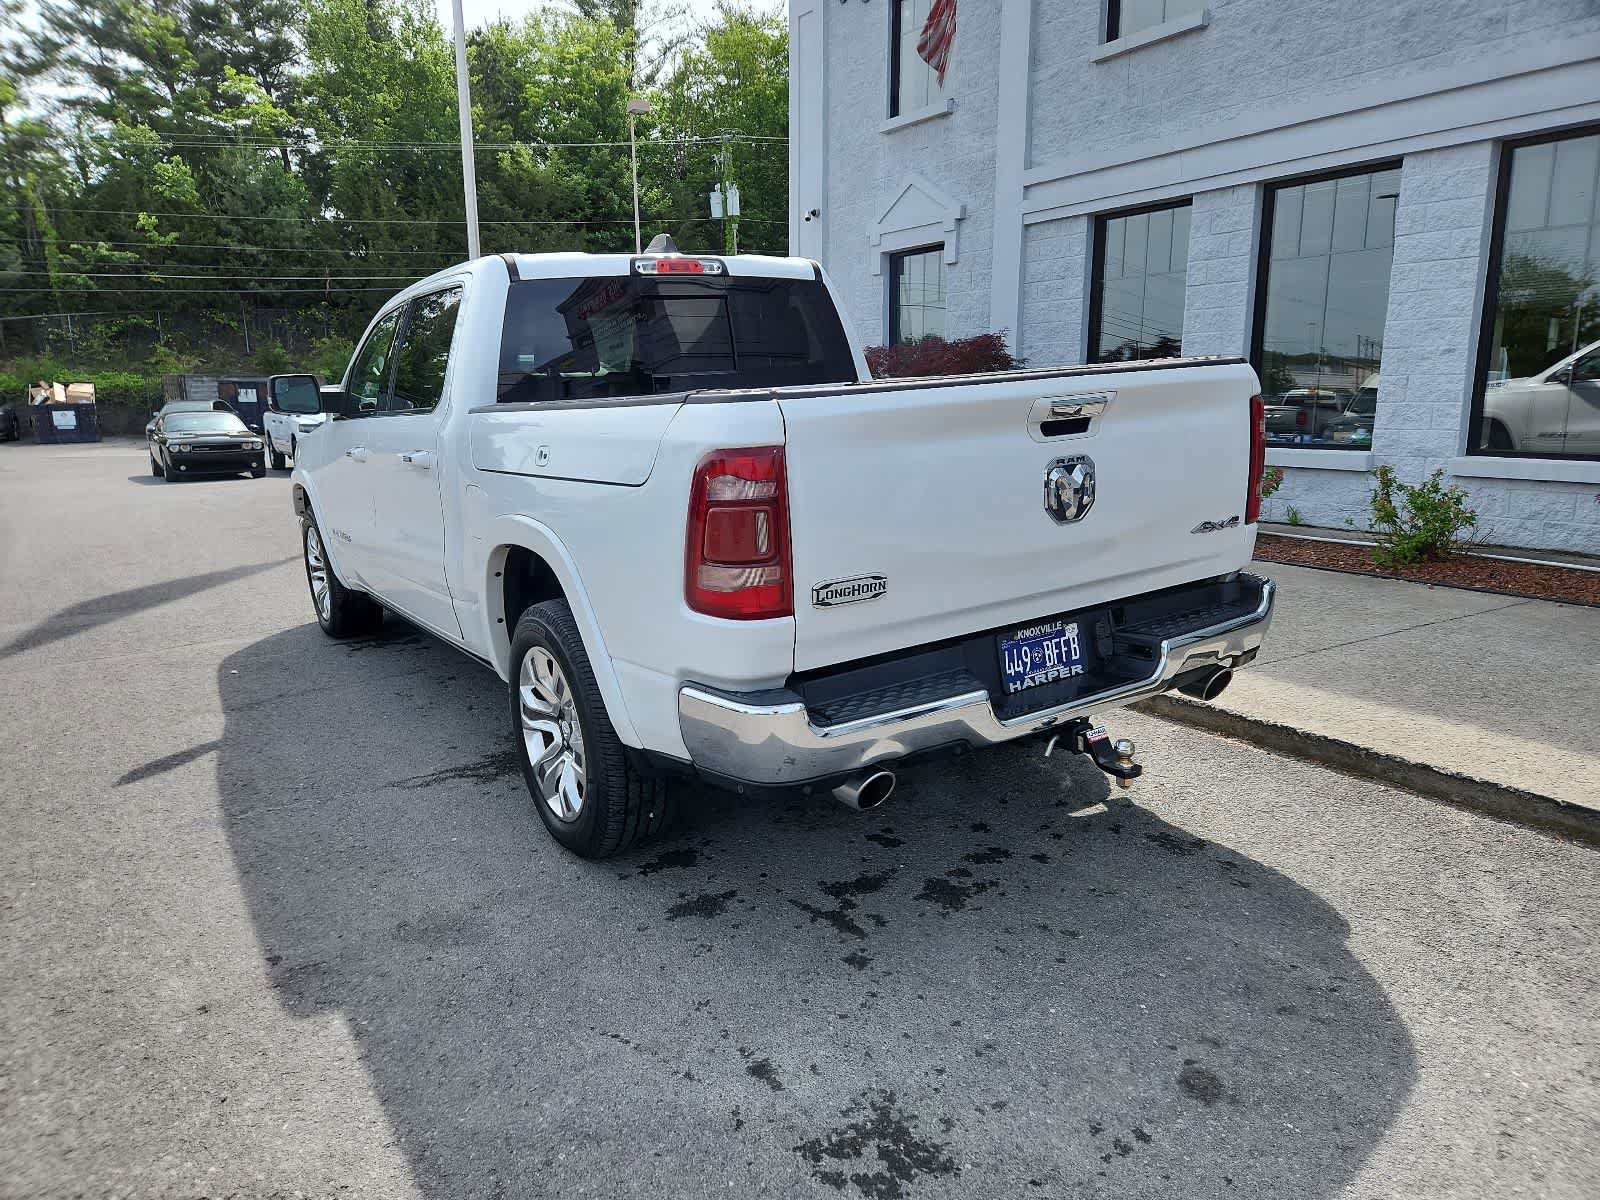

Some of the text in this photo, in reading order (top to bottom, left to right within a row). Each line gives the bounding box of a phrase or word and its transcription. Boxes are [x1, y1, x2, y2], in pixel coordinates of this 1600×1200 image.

[1056, 456, 1086, 464] RAM
[816, 581, 887, 602] LONGHORN
[1017, 621, 1062, 640] KNOXVILLE
[1005, 647, 1031, 676] 449
[1043, 636, 1080, 666] BFFB
[1009, 665, 1084, 692] HARPER
